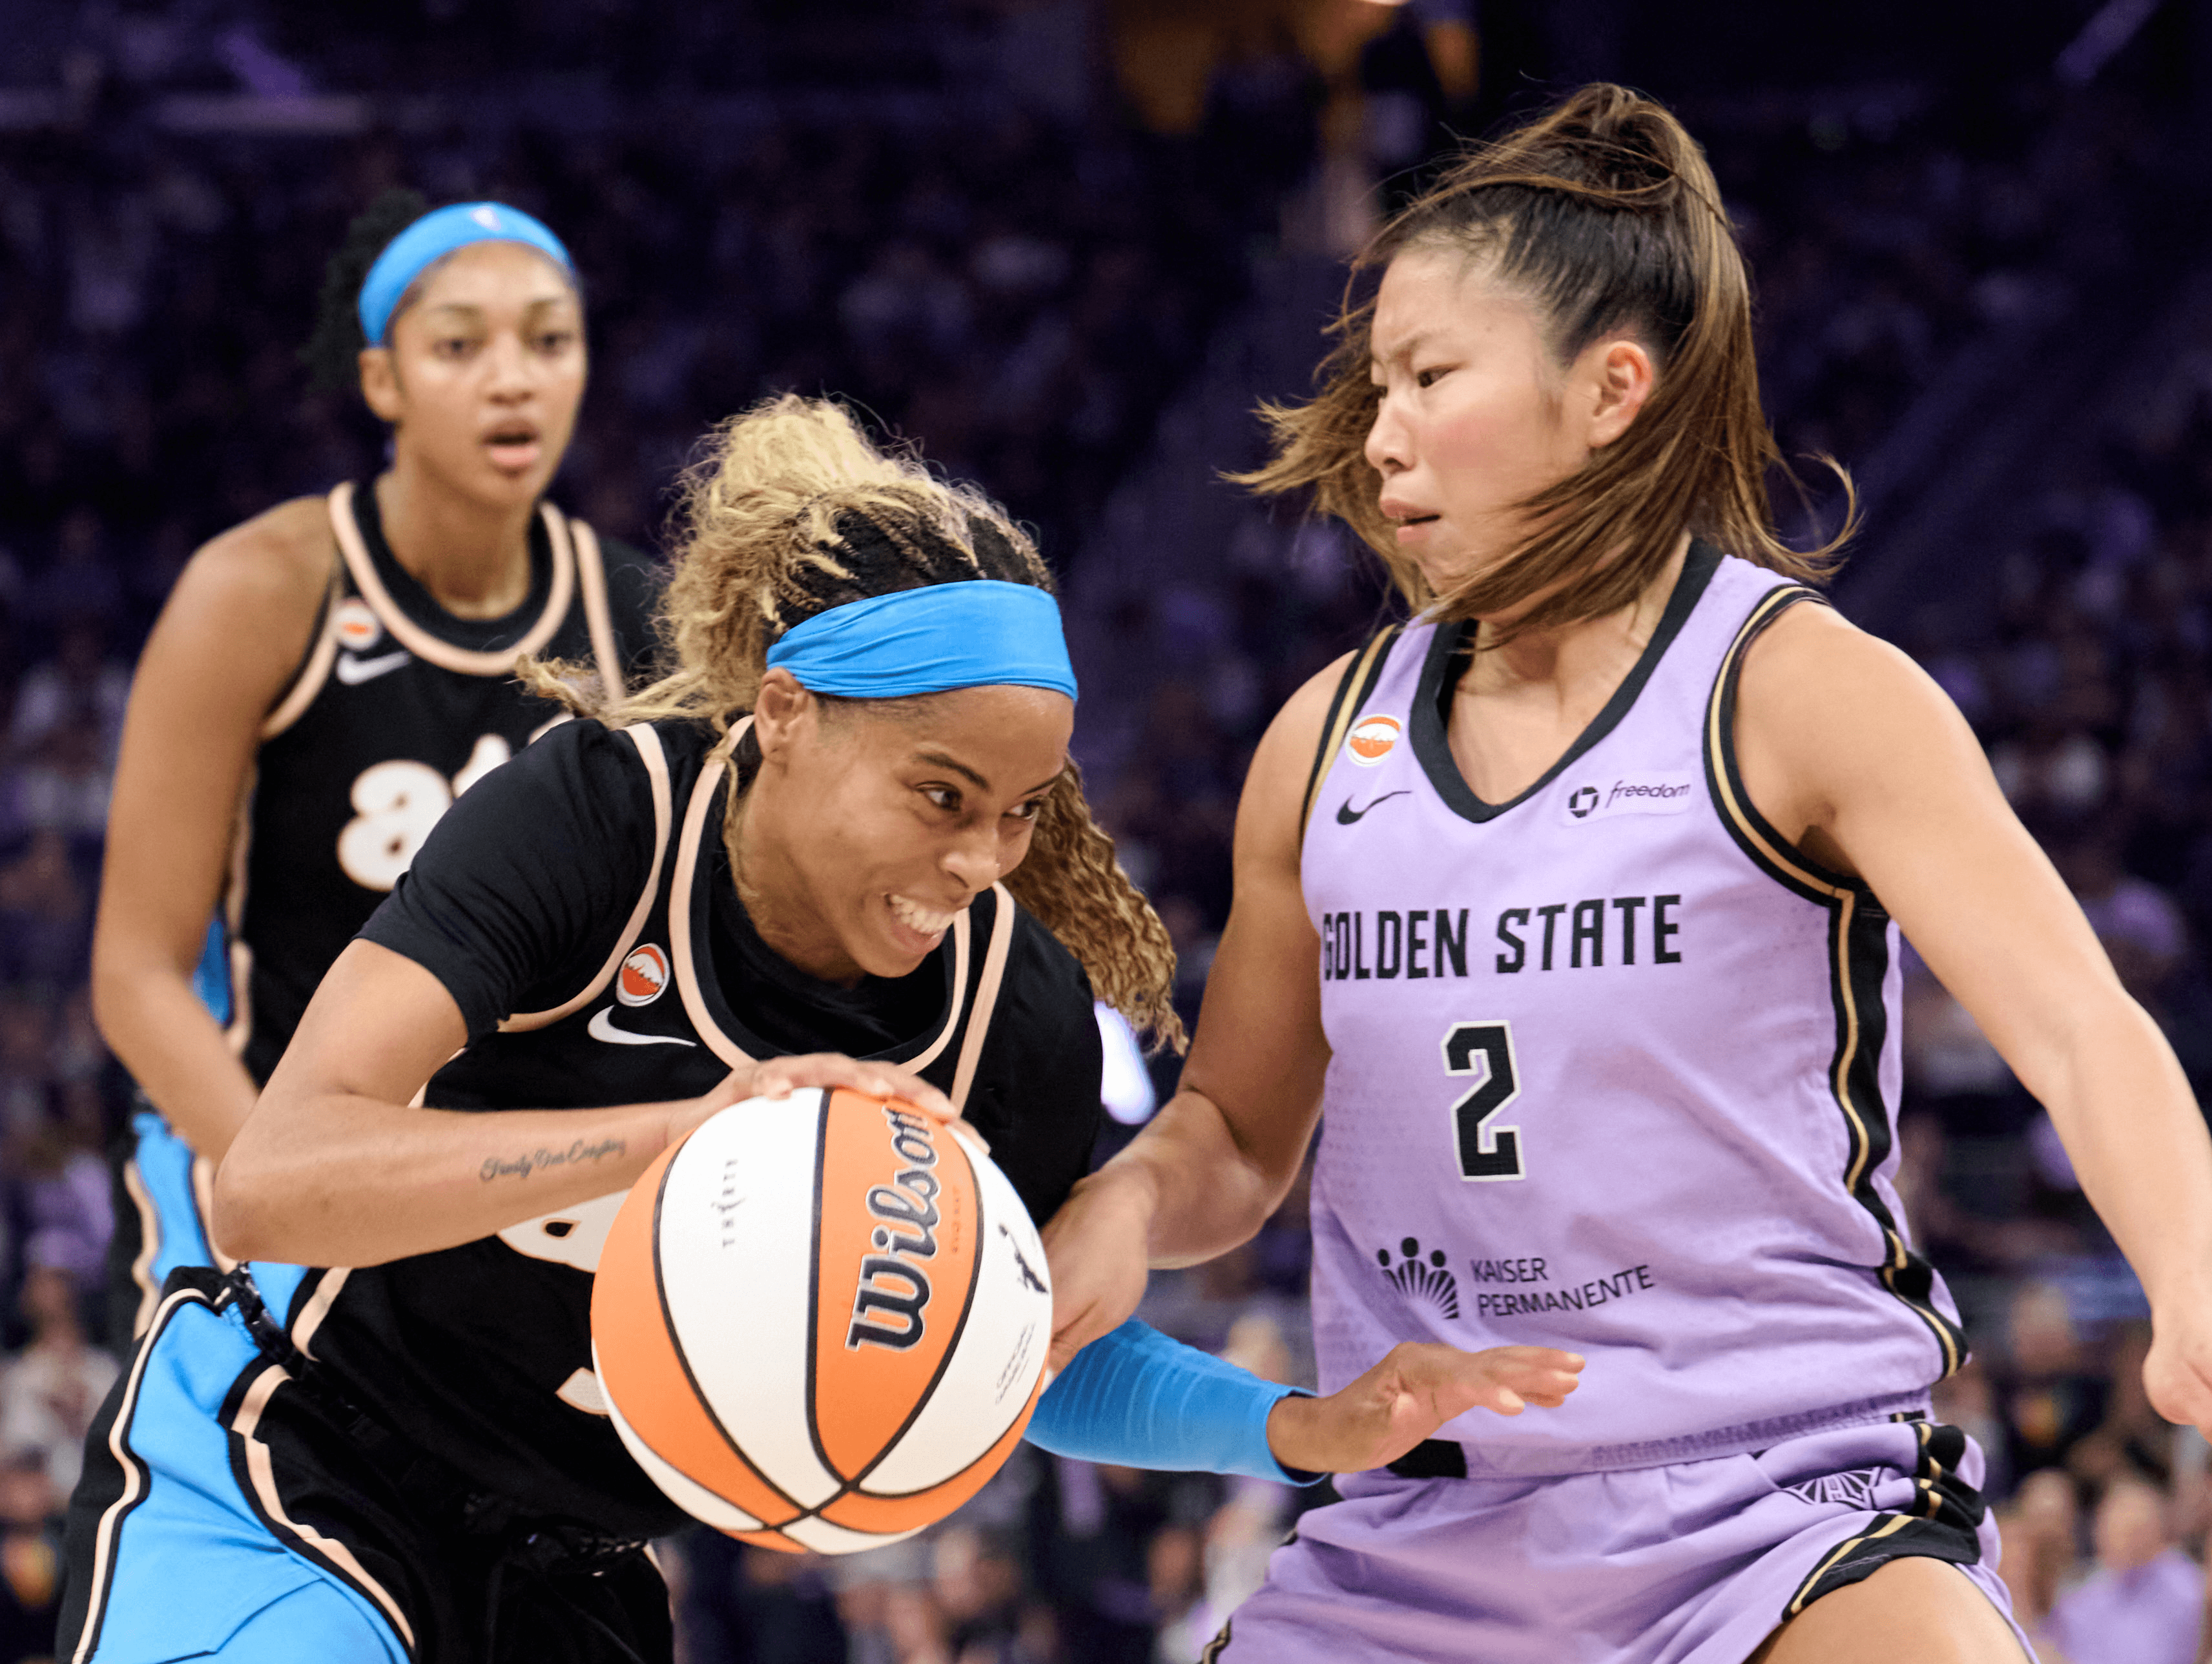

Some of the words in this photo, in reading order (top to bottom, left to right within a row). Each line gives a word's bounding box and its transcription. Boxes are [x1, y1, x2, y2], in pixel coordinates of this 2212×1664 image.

[1604, 779, 1691, 808] freedom
[1324, 908, 1470, 981] GOLDEN
[1495, 894, 1682, 974] STATE
[1440, 1020, 1525, 1182] 2
[844, 1105, 940, 1353] Wilson
[1470, 1257, 1549, 1283] KAISER
[1477, 1264, 1655, 1317] PERMANENTE
